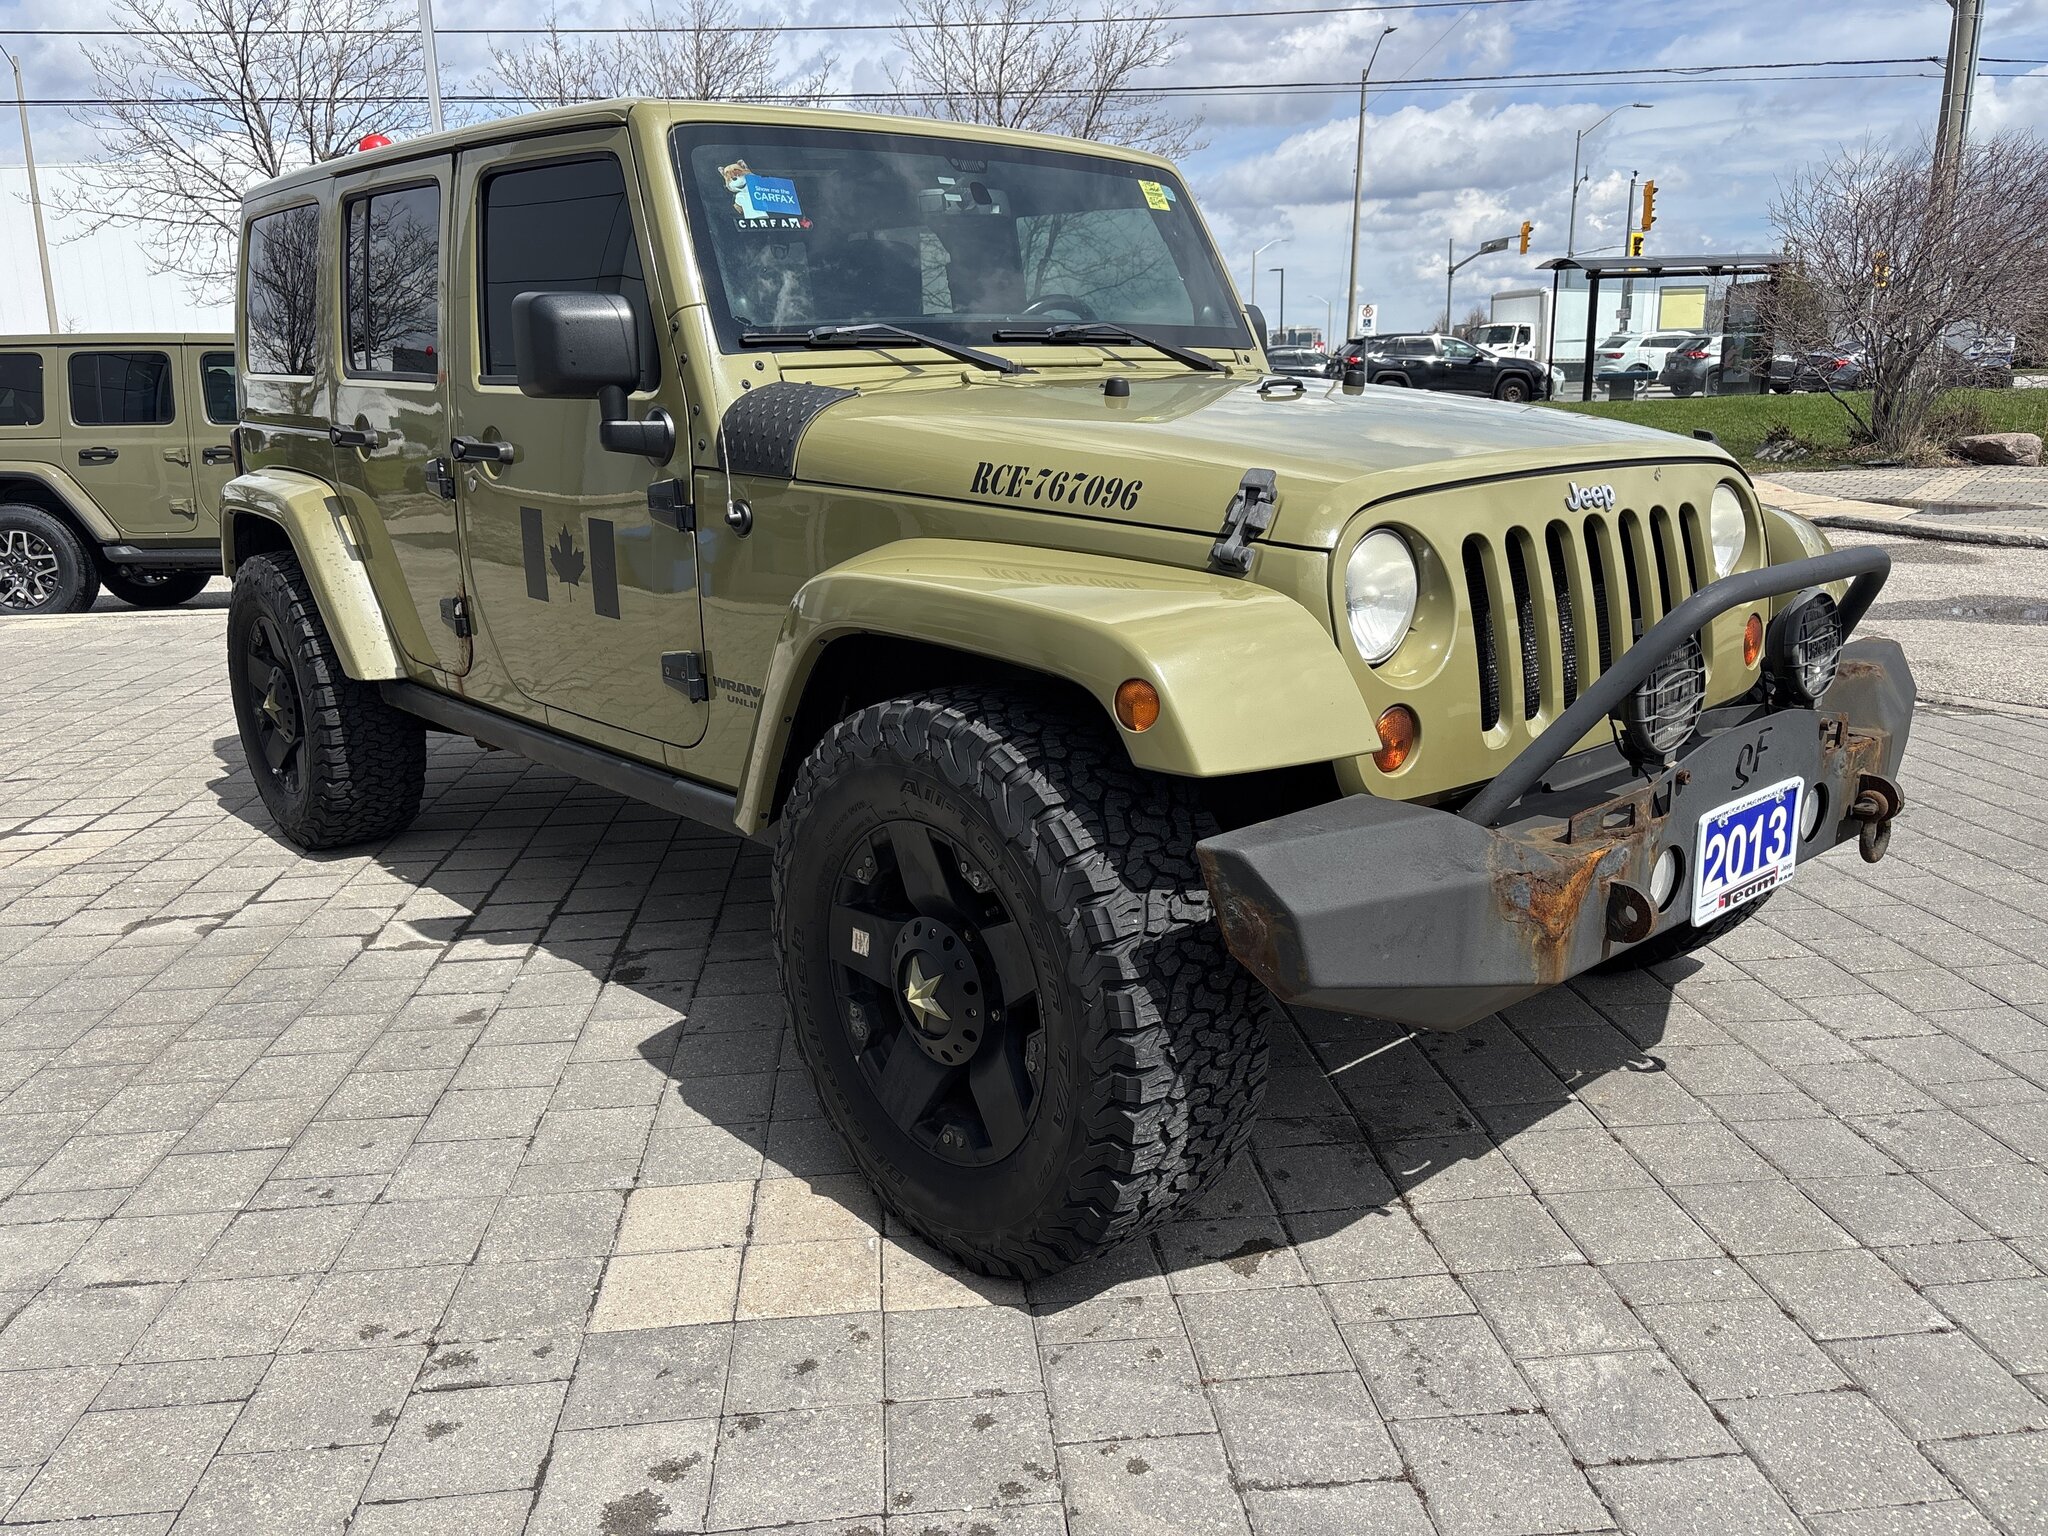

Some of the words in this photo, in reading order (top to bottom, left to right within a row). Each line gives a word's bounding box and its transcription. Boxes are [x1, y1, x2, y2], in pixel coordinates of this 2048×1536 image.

[753, 191, 795, 204] CARFAX
[969, 461, 1144, 512] RCE-767096
[1564, 481, 1617, 513] Jeep
[1702, 805, 1788, 896] 2013
[1720, 868, 1777, 909] Team
